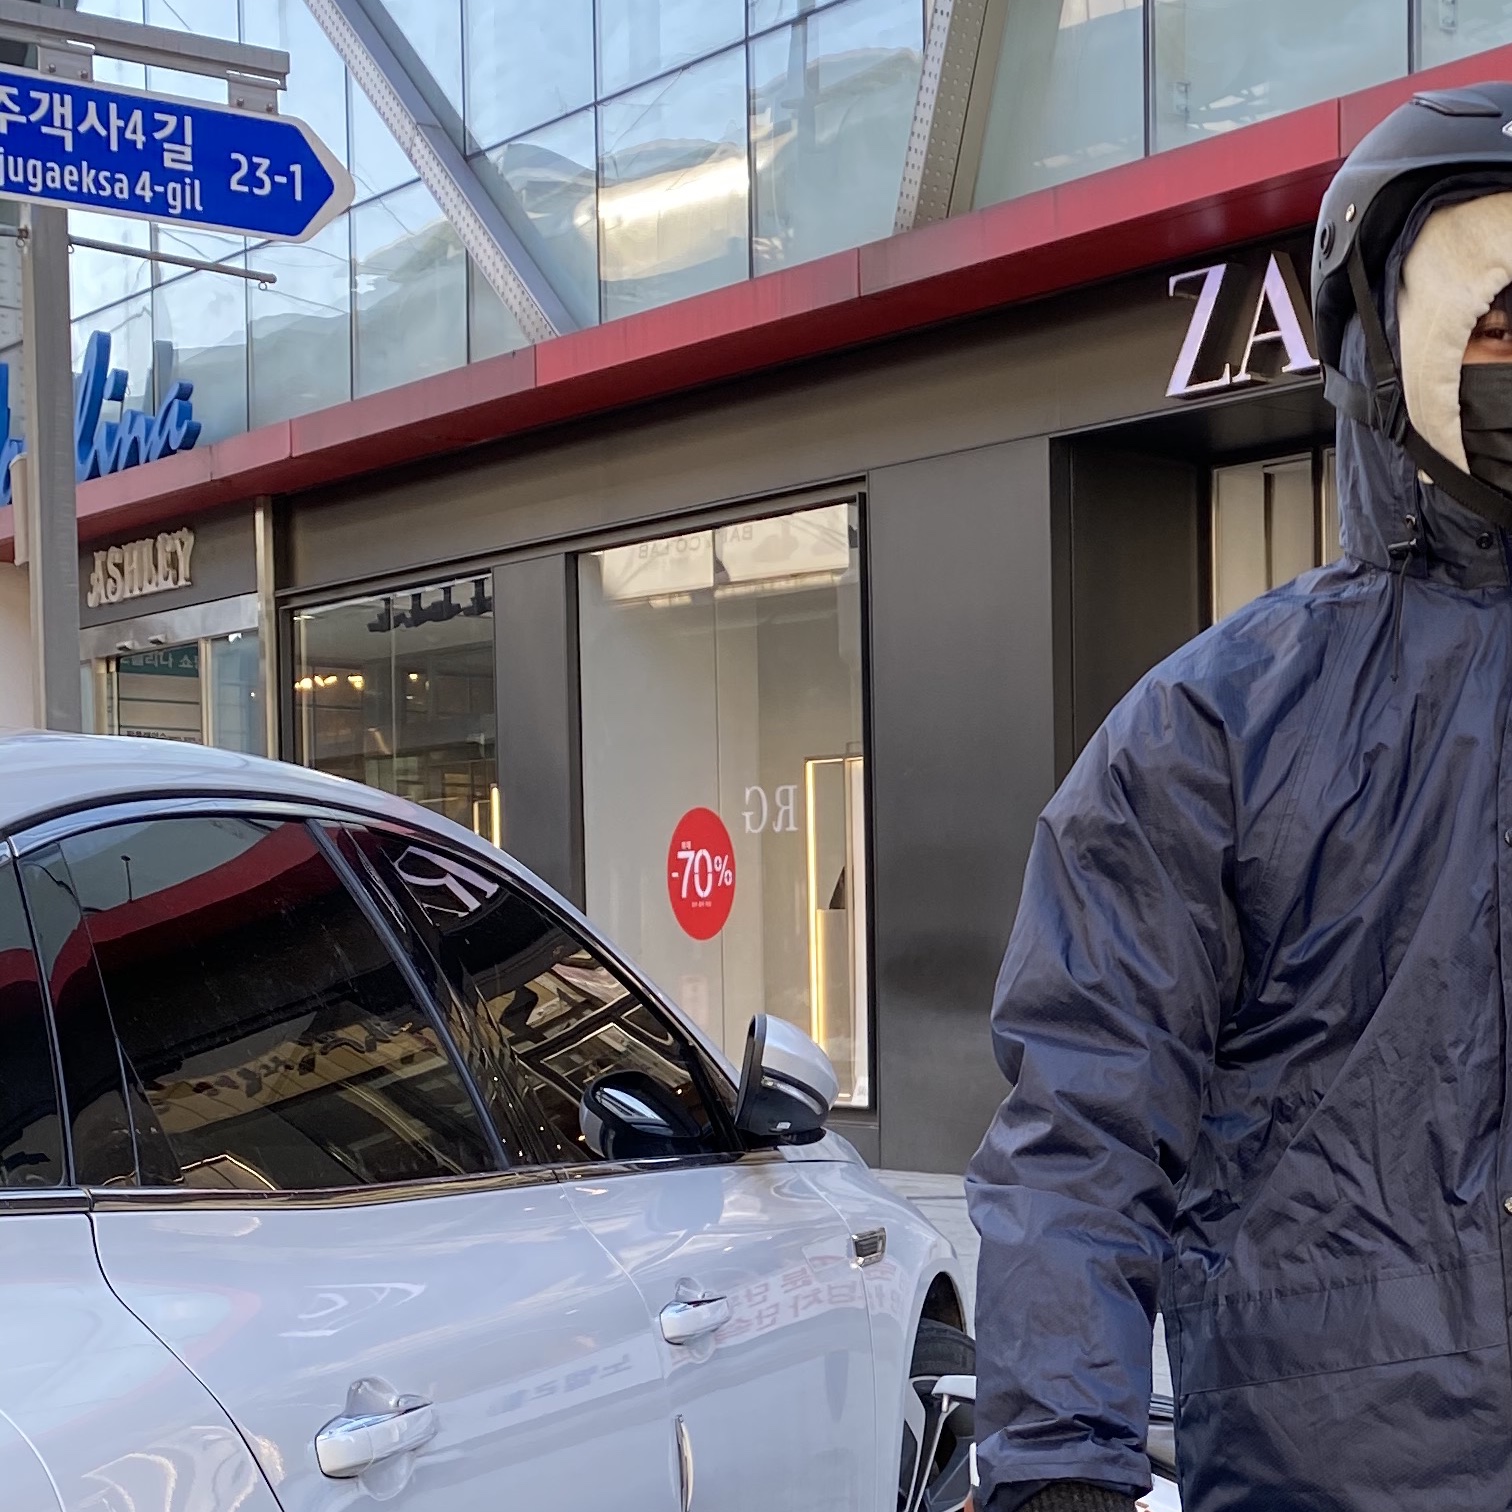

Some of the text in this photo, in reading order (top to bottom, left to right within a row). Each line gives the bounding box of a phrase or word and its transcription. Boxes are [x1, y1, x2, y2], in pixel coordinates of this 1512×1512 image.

[134, 171, 203, 214] 4-gil
[230, 153, 302, 201] 23-1
[1165, 252, 1320, 397] ZA
[87, 527, 195, 608] ASHLEY
[671, 848, 733, 899] -70%
